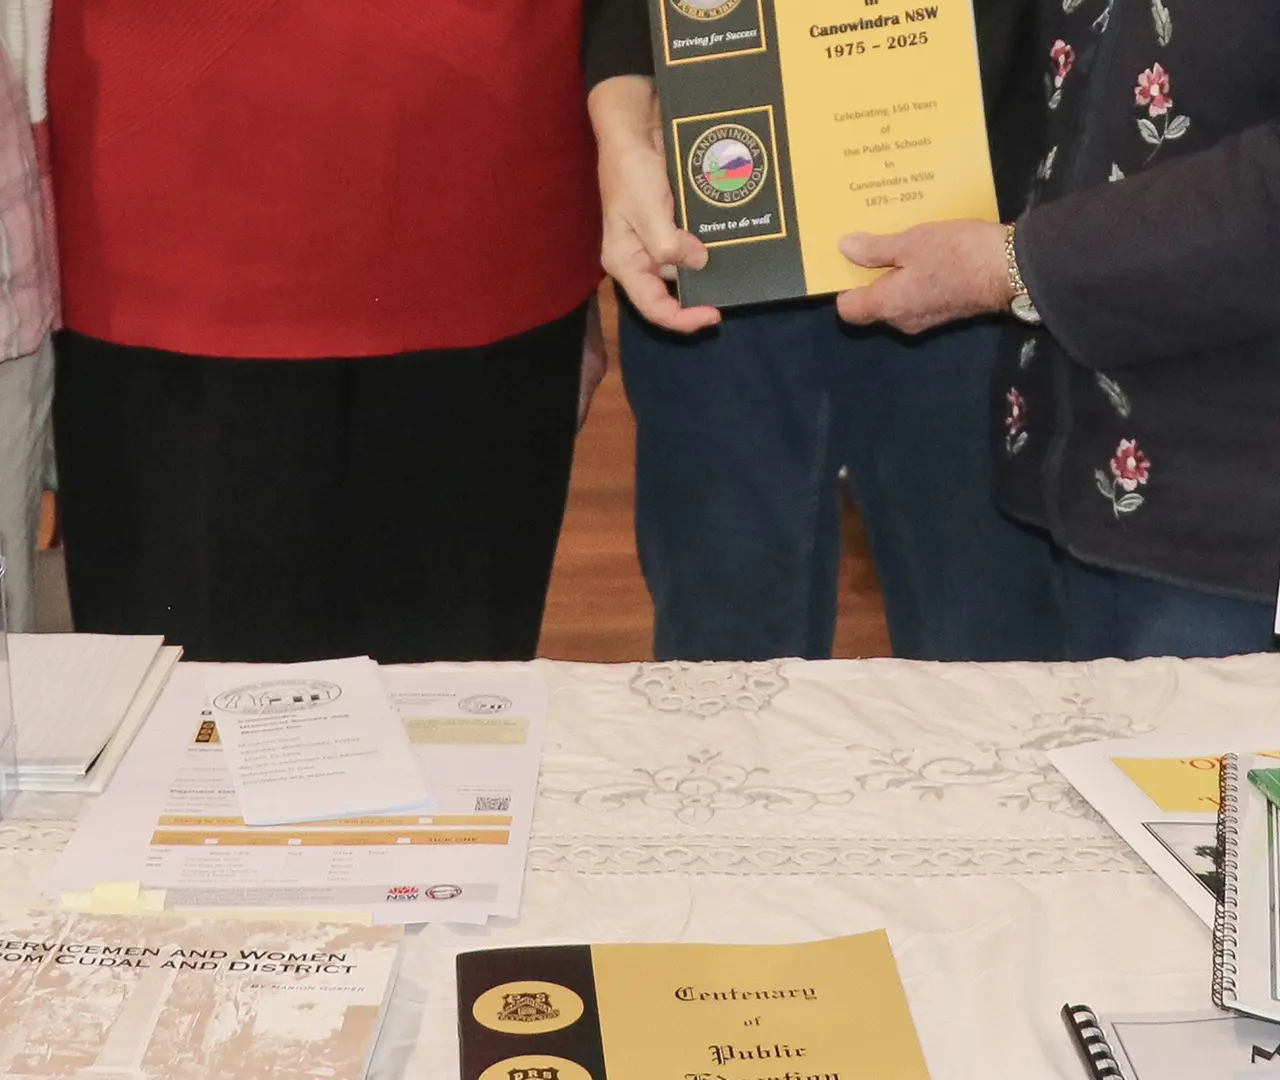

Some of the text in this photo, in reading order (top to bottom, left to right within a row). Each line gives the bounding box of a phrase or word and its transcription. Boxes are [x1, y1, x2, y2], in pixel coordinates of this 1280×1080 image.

[809, 6, 938, 38] Canowindra NSW
[673, 29, 757, 49] Striving for Success
[824, 31, 928, 59] 1975 2025
[834, 100, 938, 122] Celebrating 150 Years
[693, 128, 760, 165] CANOWINDRA
[843, 137, 932, 157] the Public Schools
[695, 164, 763, 202] HIGH SCHOOL
[849, 171, 935, 191] Canowindra NSW
[699, 213, 772, 233] Strive to do well
[387, 893, 419, 901] NSW
[674, 985, 818, 1002] Centenary
[743, 1016, 762, 1026] of
[708, 1043, 808, 1065] Public
